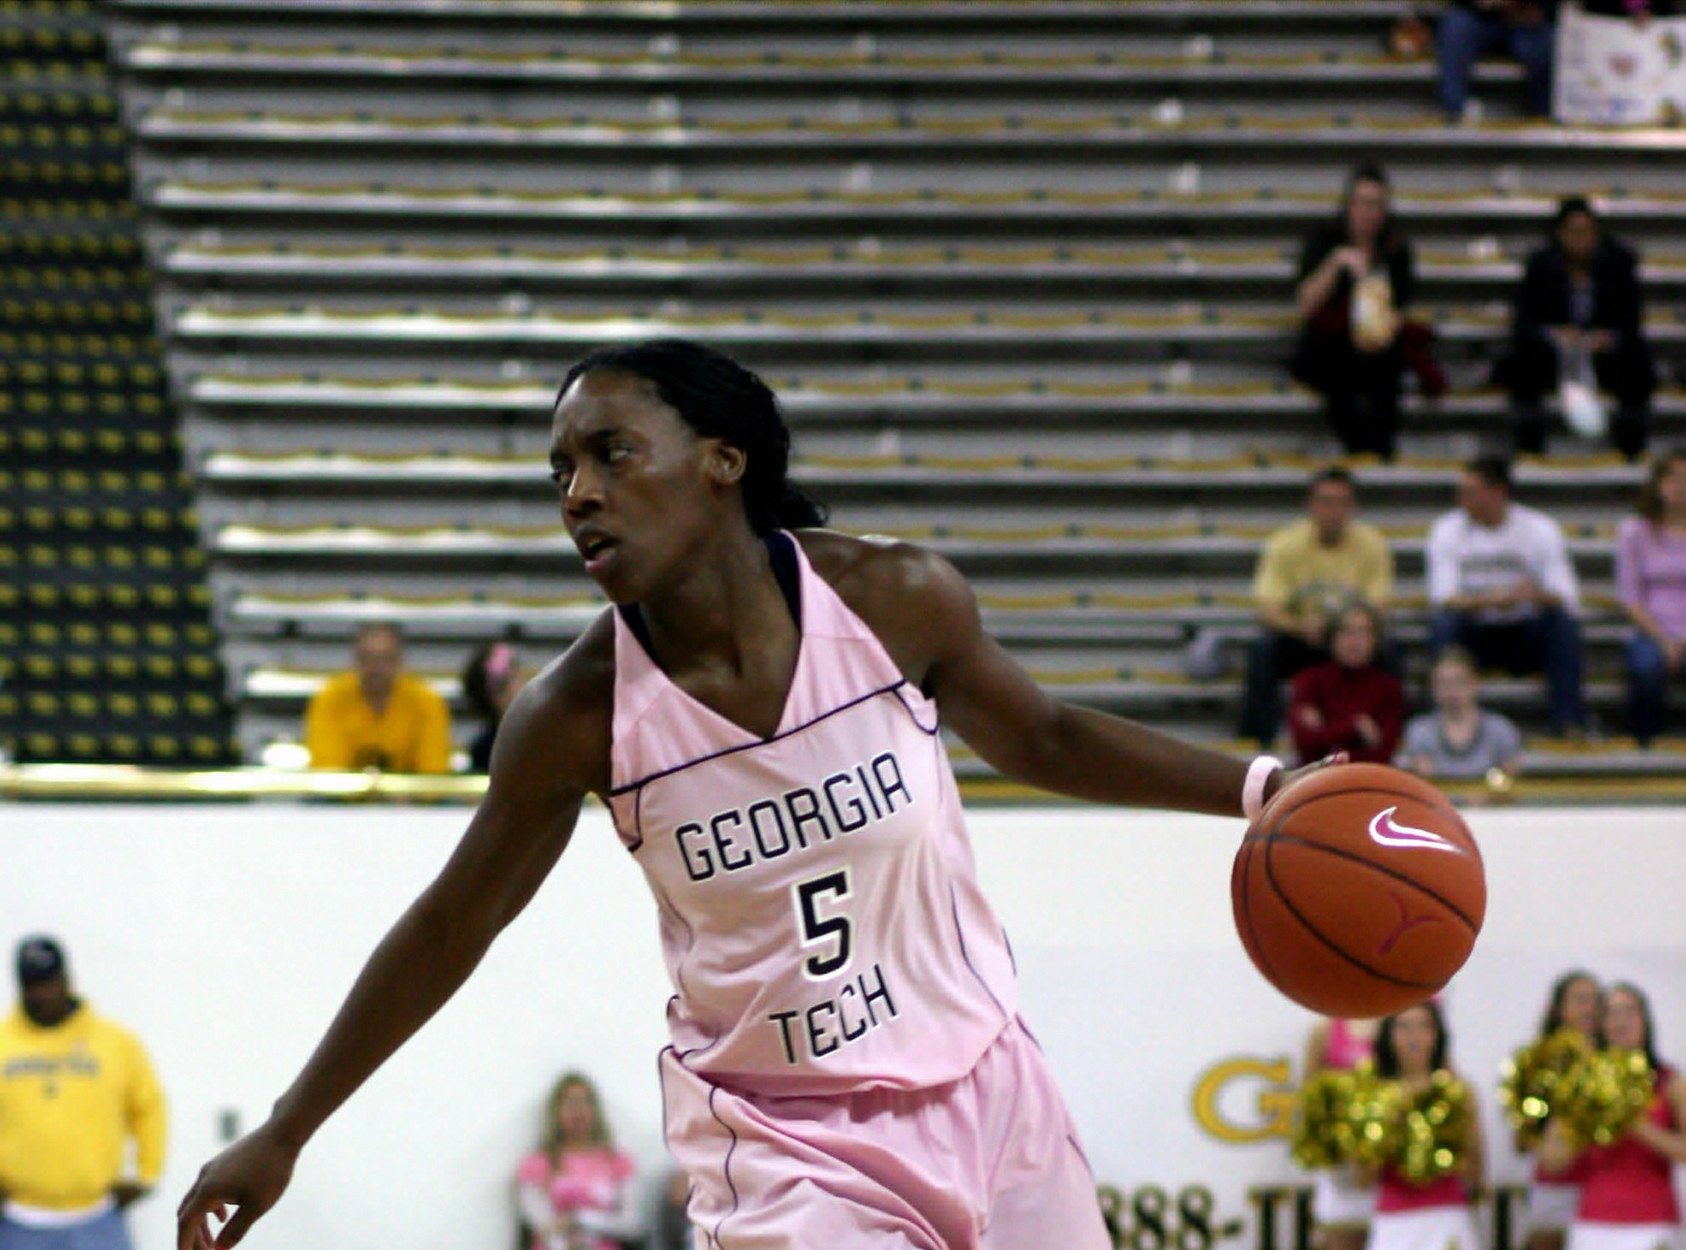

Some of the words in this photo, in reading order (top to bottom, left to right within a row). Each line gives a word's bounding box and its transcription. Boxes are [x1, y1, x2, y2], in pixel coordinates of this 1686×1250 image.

[675, 751, 913, 883] GEORGIA
[797, 869, 852, 979] 5
[767, 962, 899, 1065] TECH
